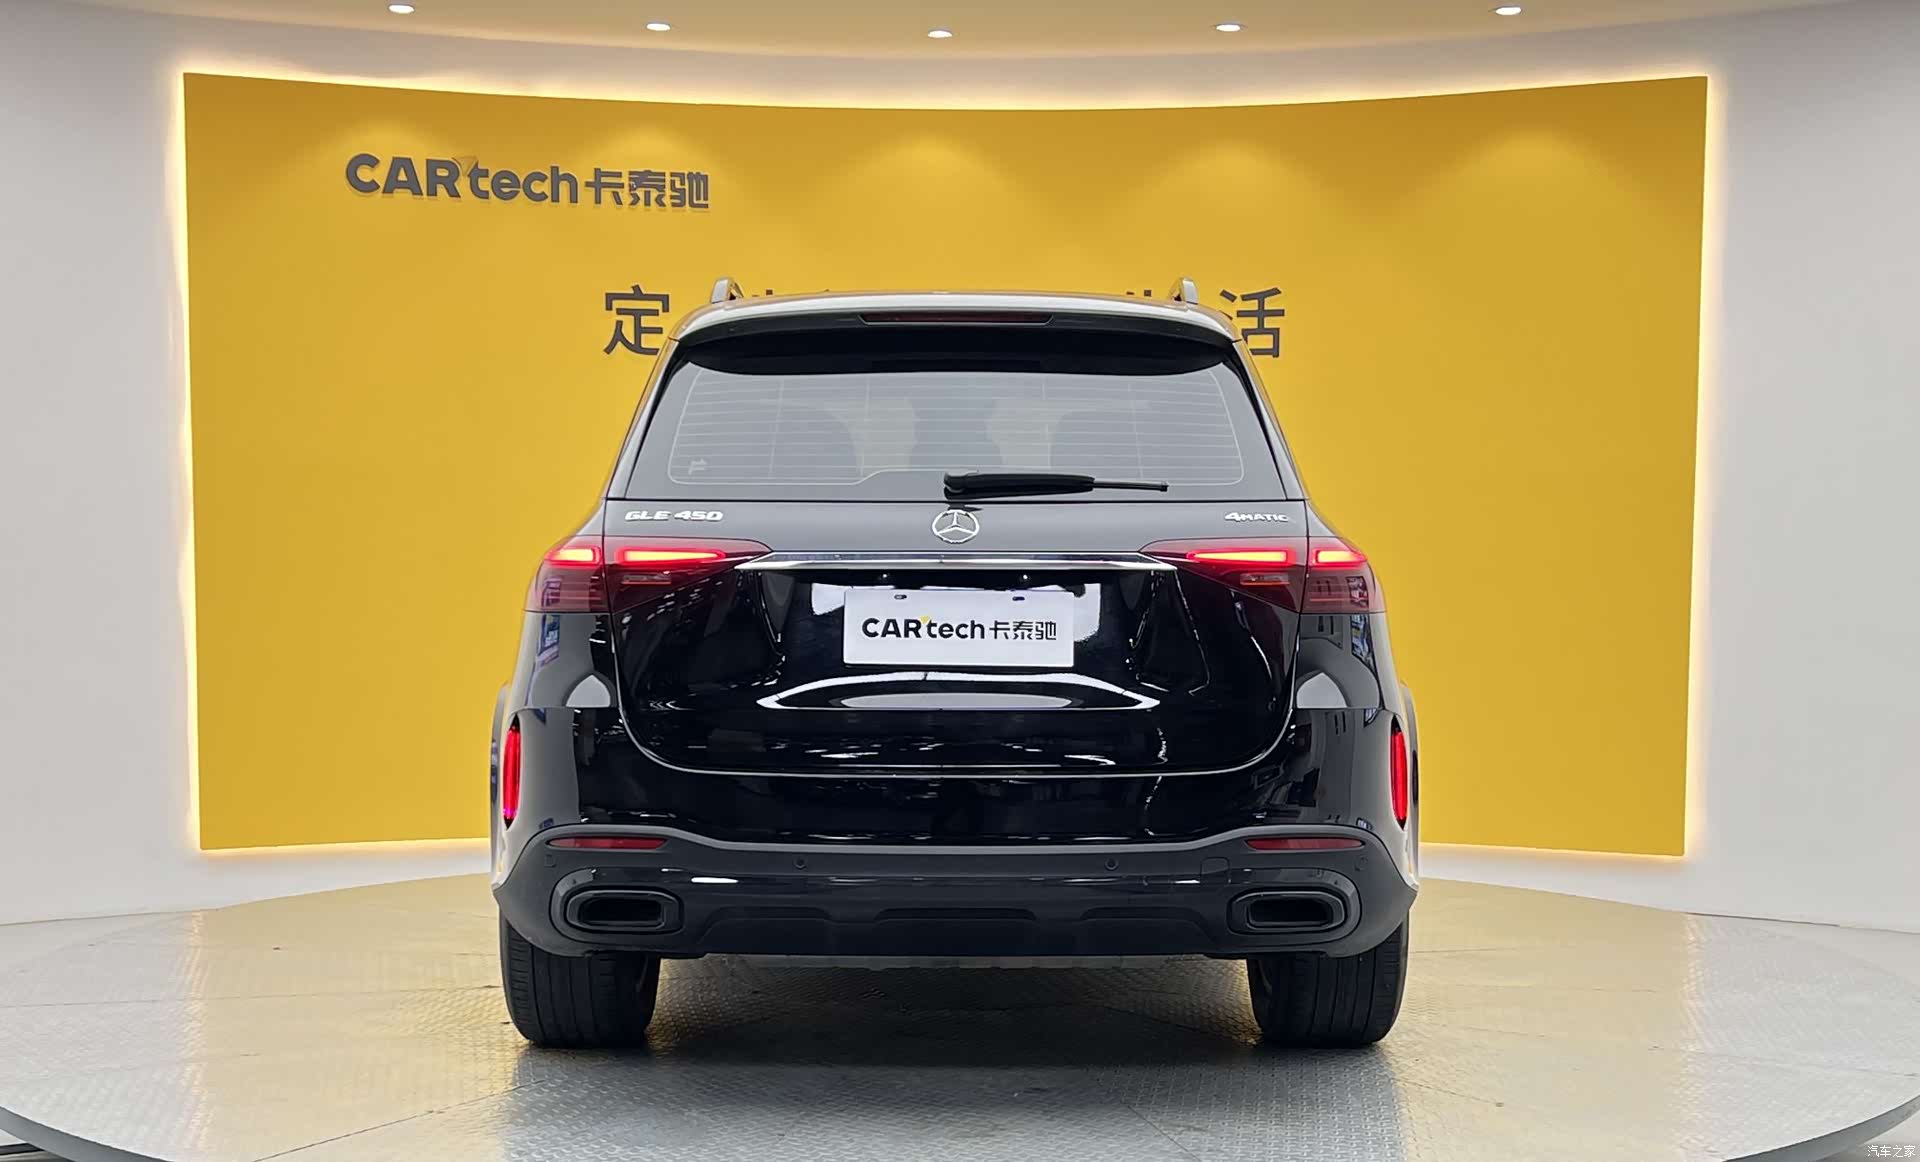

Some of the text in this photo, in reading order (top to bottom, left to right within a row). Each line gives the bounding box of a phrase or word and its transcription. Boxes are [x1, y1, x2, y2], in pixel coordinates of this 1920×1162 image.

[585, 167, 709, 209] 卡泰驰
[625, 511, 723, 521] GLE 450
[1224, 512, 1289, 522] 4MATIC
[989, 620, 1057, 640] 卡泰驰
